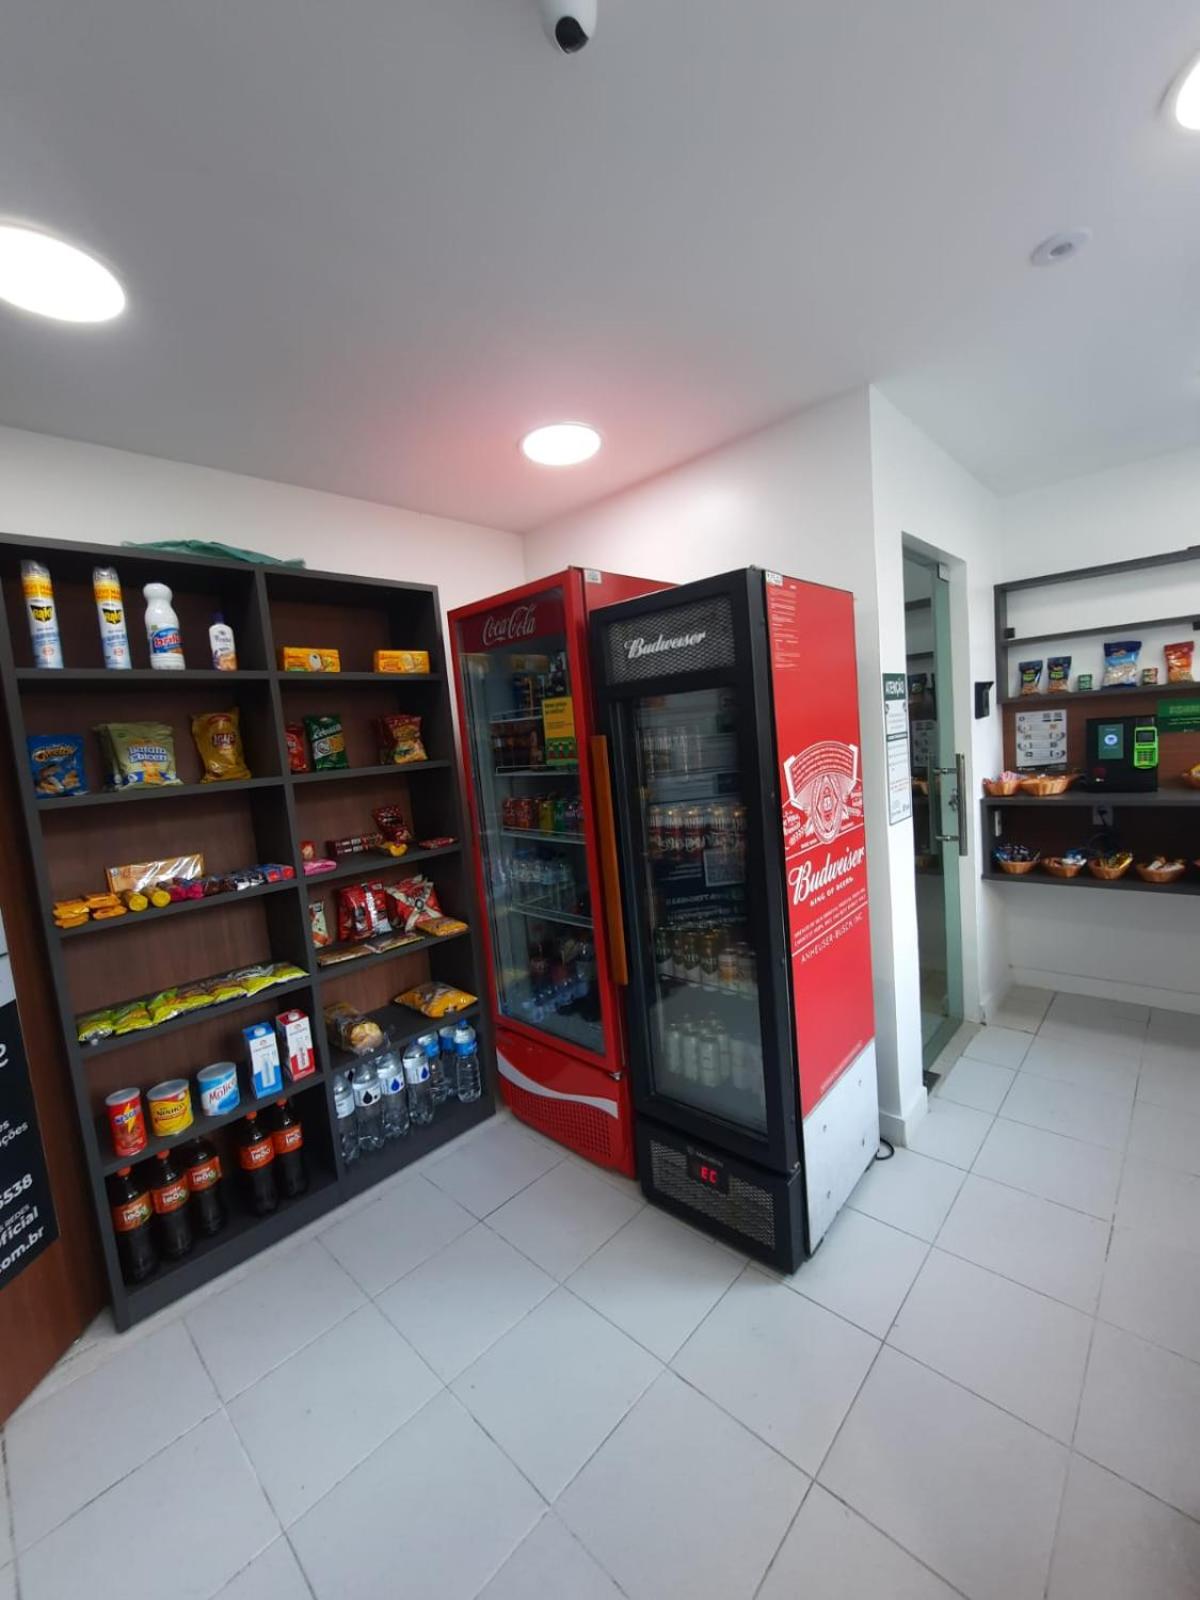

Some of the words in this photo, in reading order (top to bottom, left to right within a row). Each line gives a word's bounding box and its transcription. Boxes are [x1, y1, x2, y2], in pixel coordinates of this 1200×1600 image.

[482, 603, 536, 646] Coca-Cola
[624, 632, 706, 659] Budweiser
[788, 846, 865, 905] Budweiser
[0, 1121, 29, 1148] ções
[0, 1205, 39, 1248] ficial
[0, 1226, 44, 1274] om.br
